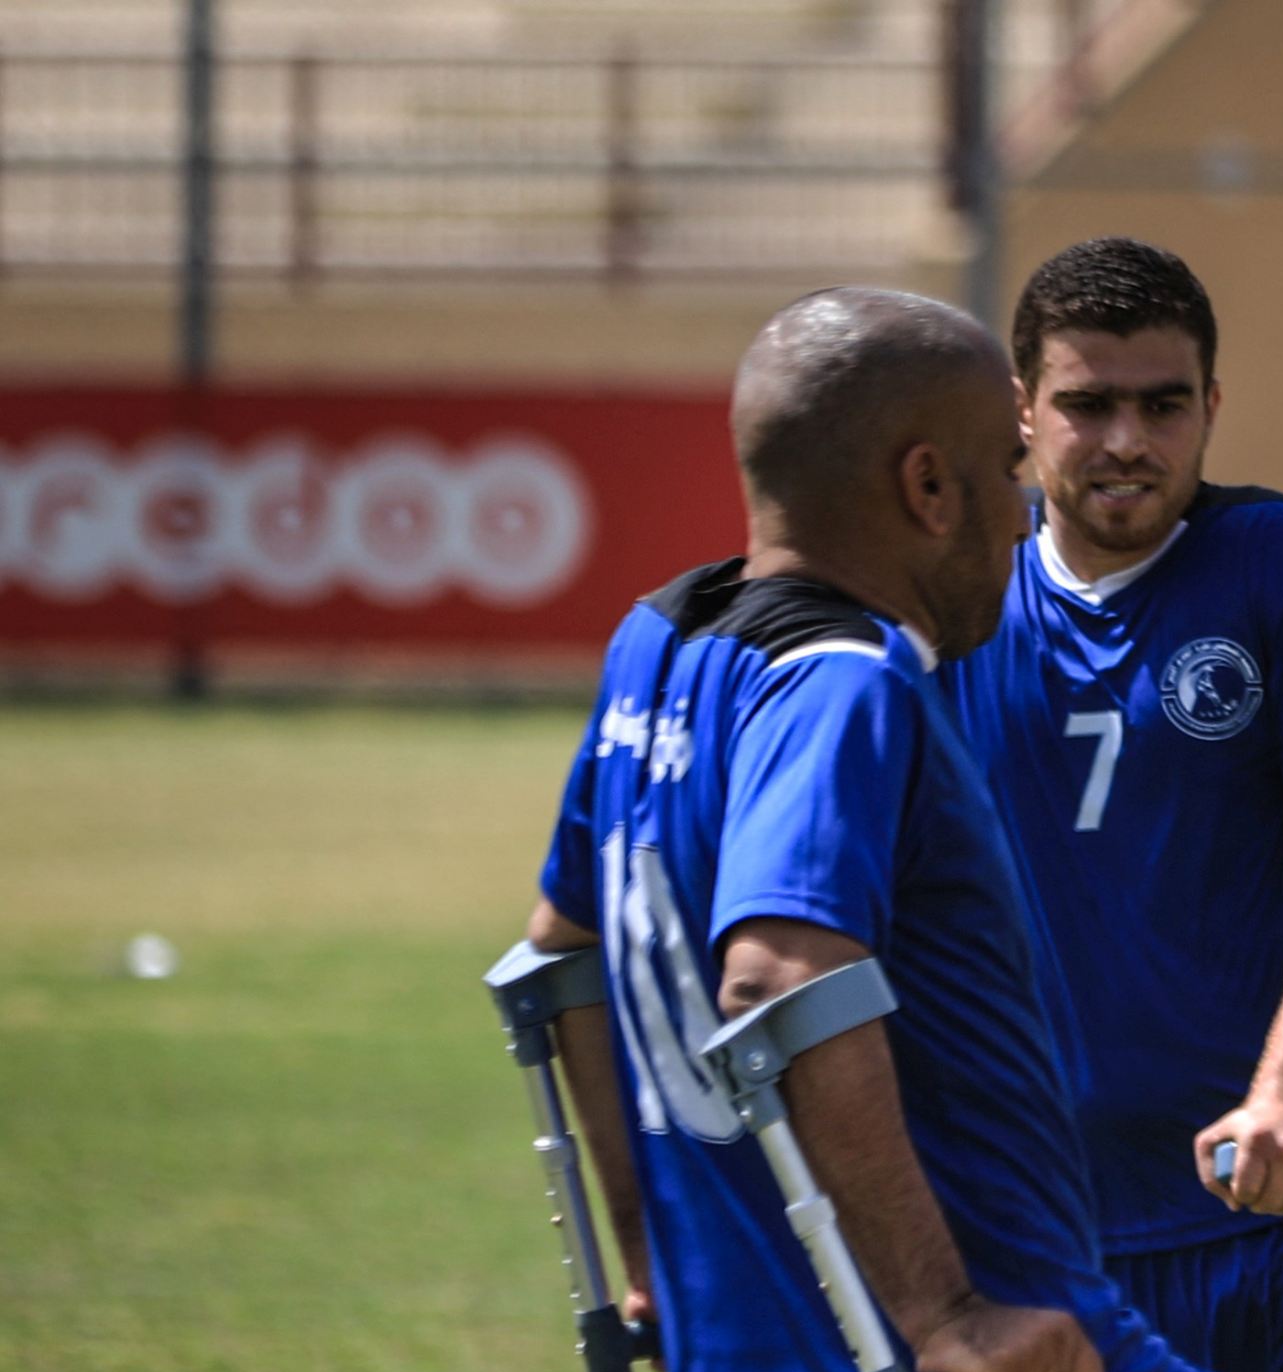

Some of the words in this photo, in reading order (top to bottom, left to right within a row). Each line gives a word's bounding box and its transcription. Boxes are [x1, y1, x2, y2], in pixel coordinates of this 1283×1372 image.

[0, 445, 584, 599] redoo
[1063, 709, 1124, 832] 7
[601, 821, 746, 1145] 10
